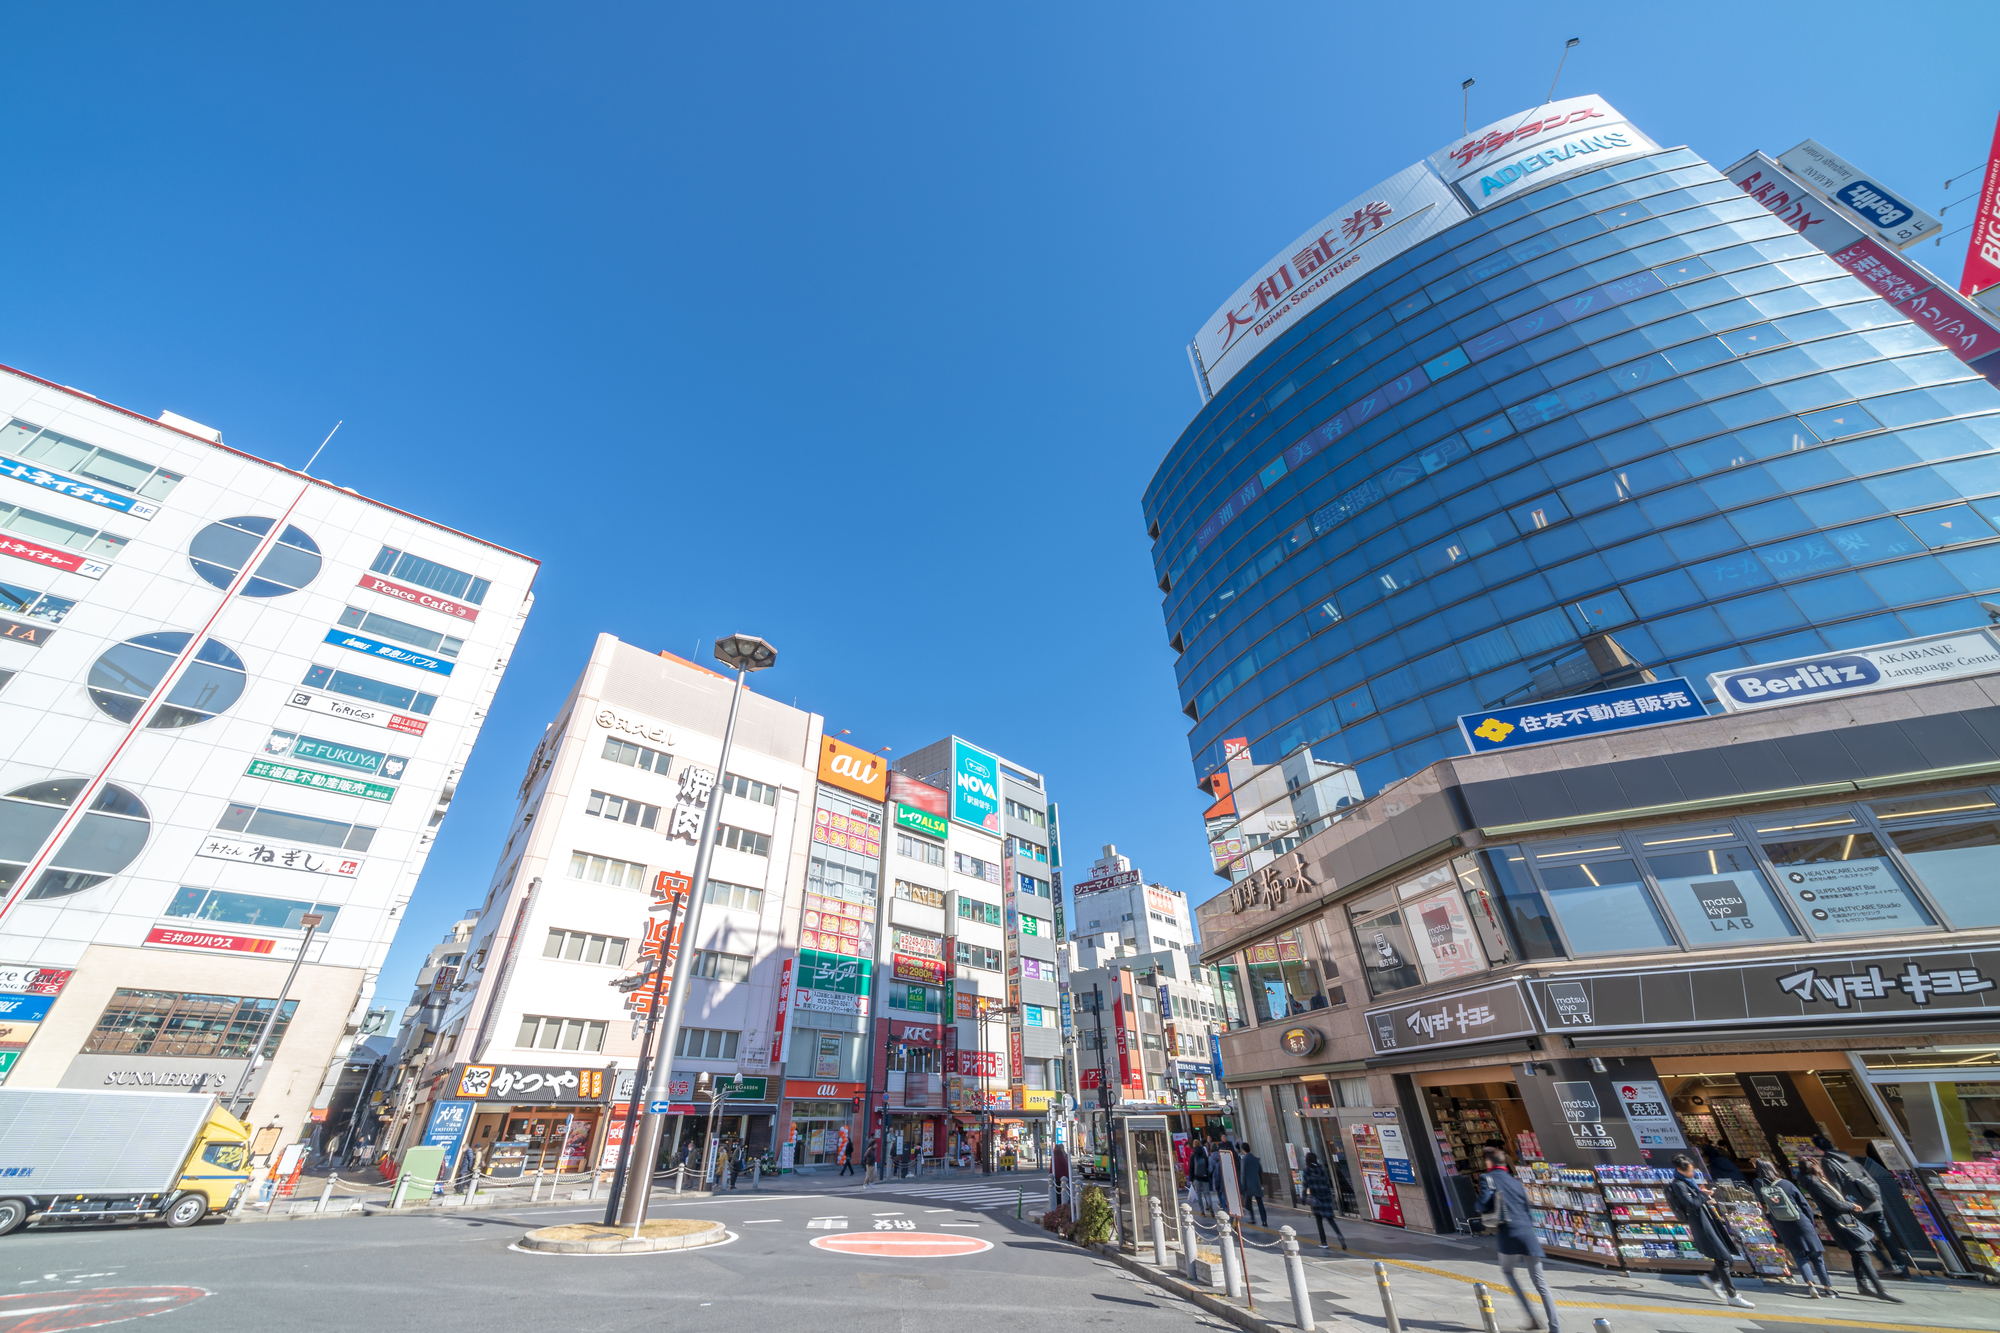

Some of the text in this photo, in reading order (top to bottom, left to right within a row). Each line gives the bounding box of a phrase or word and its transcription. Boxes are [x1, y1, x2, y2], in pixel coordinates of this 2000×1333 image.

[1456, 107, 1604, 168] アデランス
[1479, 132, 1632, 196] ADERANS
[1847, 185, 1905, 225] Berlitz
[1974, 215, 1987, 246] Karaoke
[1217, 201, 1392, 349] 大和証券
[1254, 253, 1360, 336] Daiwa Securities
[1852, 255, 1978, 351] 湘南美容クリニック
[0, 459, 154, 515] ートネイチャー 8F
[83, 563, 103, 573] 7F
[371, 579, 454, 613] Peace Café
[375, 646, 439, 669] 東急リバブル
[1878, 644, 1956, 665] AKABANE
[1885, 660, 1955, 678] Language
[1735, 662, 1866, 700] Berlitz
[1519, 690, 1692, 734] 住友不動産販売
[315, 746, 376, 768] FUKUYA
[831, 755, 878, 784] au
[268, 767, 367, 795] 福屋不動産販売
[958, 770, 997, 801] NOVA
[671, 765, 715, 840] 焼肉
[206, 843, 243, 857] 牛たん
[249, 845, 325, 873] ねぎし
[1091, 862, 1122, 879] セキネ
[1804, 865, 1879, 877] HEALTHCARE Lounge
[1075, 871, 1138, 895] シューマイ・肉まん
[1815, 885, 1862, 895] SUPPLEMENT
[1702, 895, 1743, 907] matsu
[1828, 904, 1877, 913] BEAUTYCARE
[1705, 904, 1732, 920] kiyo
[1428, 923, 1450, 934] matsu
[1710, 917, 1754, 932] LAB
[160, 932, 233, 948] 三井のリハウス
[1430, 934, 1445, 946] kiyo
[1434, 943, 1457, 959] LAB
[1379, 956, 1398, 968] 処方せん
[24, 970, 65, 986] Café
[812, 961, 858, 982] エイブル
[42, 985, 59, 994] 8
[910, 986, 922, 994] レイク
[1780, 965, 1994, 1007] マツモトキヨシ
[1556, 996, 1585, 1004] matsu
[1560, 1003, 1577, 1013] kiyo
[1407, 1004, 1495, 1038] マツモトキヨシ
[1561, 1014, 1593, 1025] LAB
[902, 1026, 932, 1042] KFC
[1117, 1027, 1126, 1054] アコム
[1382, 1039, 1396, 1048] LAB
[962, 1060, 995, 1075] アイフル
[104, 1070, 227, 1087] SUNMERRY'S
[491, 1067, 579, 1098] かつや
[817, 1084, 838, 1096] au
[1085, 1101, 1095, 1110] UQ
[1563, 1099, 1596, 1109] matsu
[1632, 1103, 1661, 1116] 免税
[1762, 1099, 1788, 1107] LAB
[436, 1106, 464, 1124] 大戸屋
[1567, 1108, 1585, 1120] kiyo
[1569, 1125, 1606, 1137] LAB
[1577, 1138, 1613, 1147] 処方せん受付
